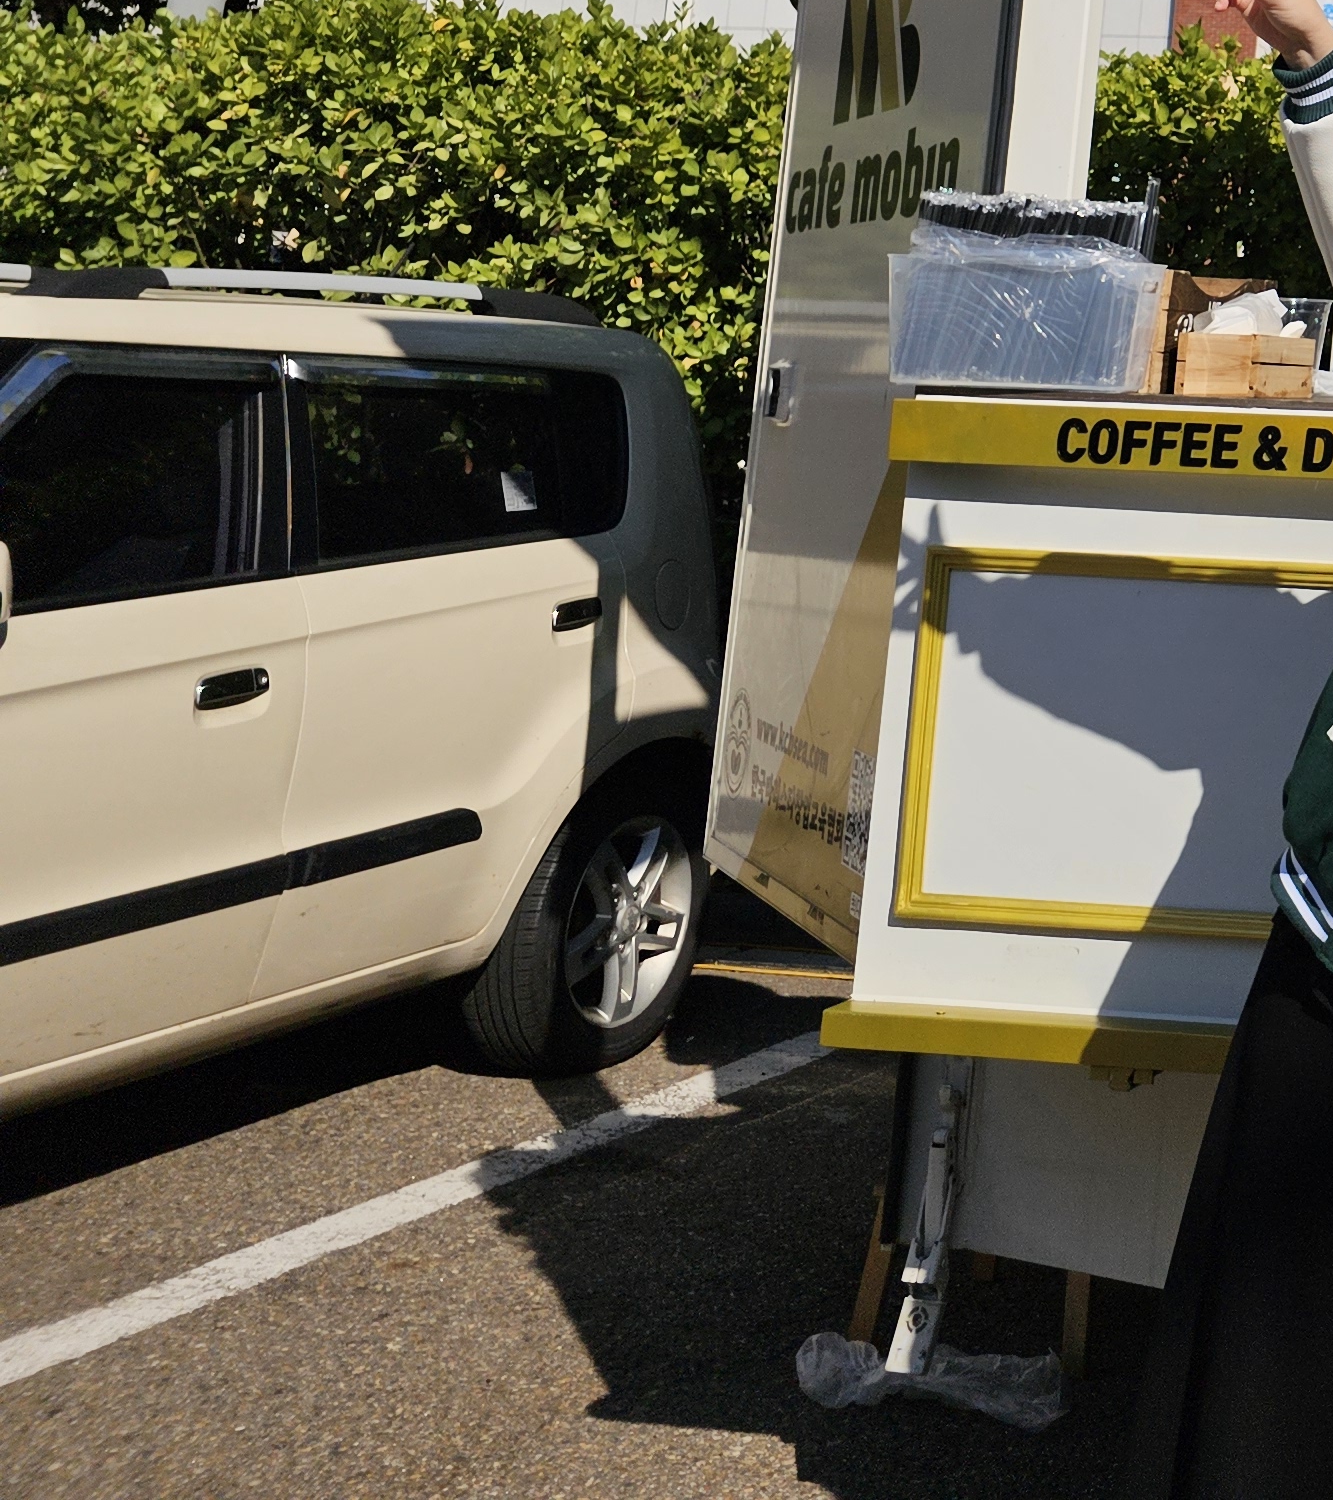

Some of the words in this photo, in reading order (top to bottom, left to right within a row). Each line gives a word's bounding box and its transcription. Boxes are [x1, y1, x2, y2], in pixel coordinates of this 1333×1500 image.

[785, 145, 845, 234] cafe
[850, 127, 960, 225] mobin
[1056, 417, 1243, 469] COFFEE
[1253, 426, 1289, 471] &
